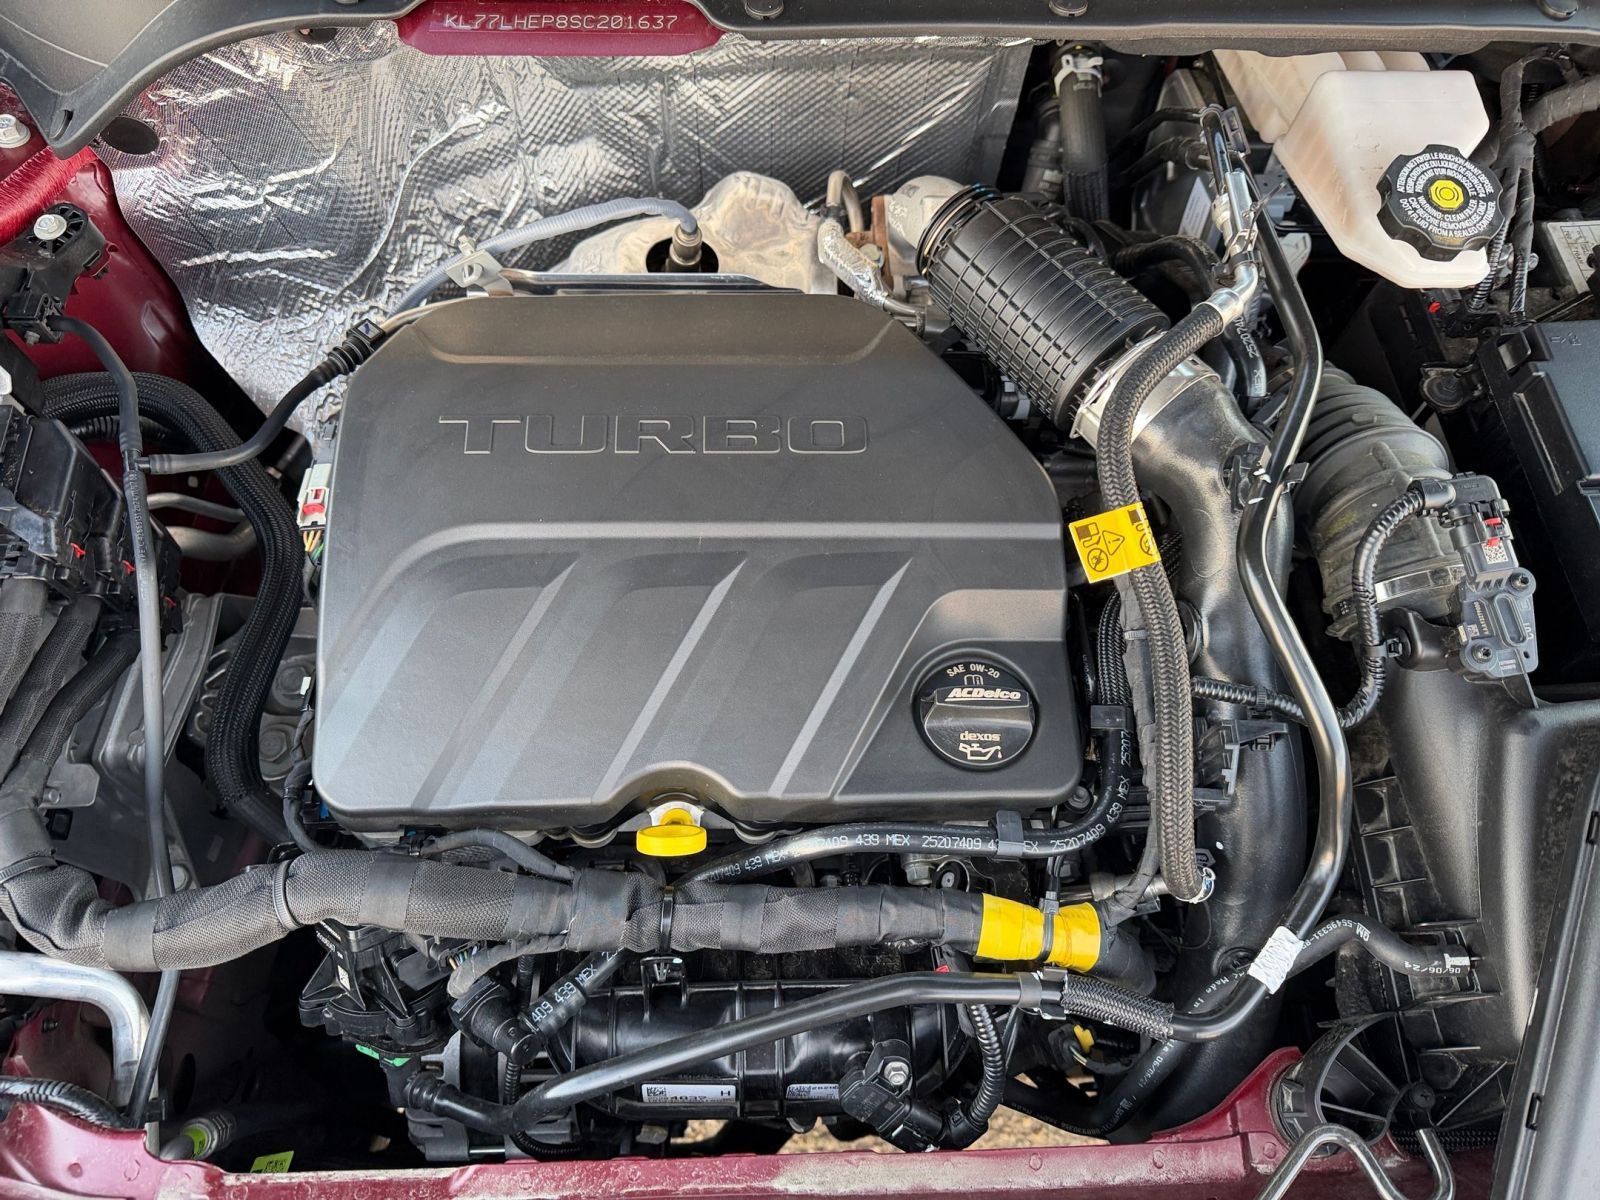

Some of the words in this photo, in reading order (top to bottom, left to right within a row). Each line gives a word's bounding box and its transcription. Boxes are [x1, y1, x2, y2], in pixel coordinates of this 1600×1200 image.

[444, 14, 679, 30] KL77LHEP8SC201637
[1439, 154, 1466, 165] BOUCHON
[1463, 161, 1482, 176] AVANT
[1458, 165, 1467, 174] DE
[1400, 199, 1412, 211] DOT
[1410, 213, 1429, 229] FLUID
[1427, 225, 1448, 236] FROM
[1453, 227, 1479, 237] SEALED
[1475, 201, 1497, 231] CONTAINER
[1408, 197, 1421, 210] CAP
[1416, 208, 1440, 226] BEFORE
[1476, 200, 1487, 216] ONLY
[1444, 213, 1466, 221] CLEAN
[1464, 200, 1477, 216] FILLER
[1233, 315, 1258, 358] 2520740
[438, 414, 869, 455] TURBO
[946, 664, 966, 677] SAE
[969, 663, 1000, 679] 0W-20
[947, 687, 1022, 699] ACDelco
[960, 730, 1001, 741] dexos
[744, 855, 763, 872] 439
[765, 849, 786, 865] MEX
[855, 833, 880, 846] 439
[885, 833, 911, 847] MEX
[921, 835, 982, 850] 25207409
[1023, 840, 1040, 853] EX
[1049, 823, 1107, 852] 25207409
[1106, 802, 1124, 823] 439
[1116, 775, 1131, 801] MEX
[554, 981, 578, 1004] 439
[574, 963, 599, 987] MEX
